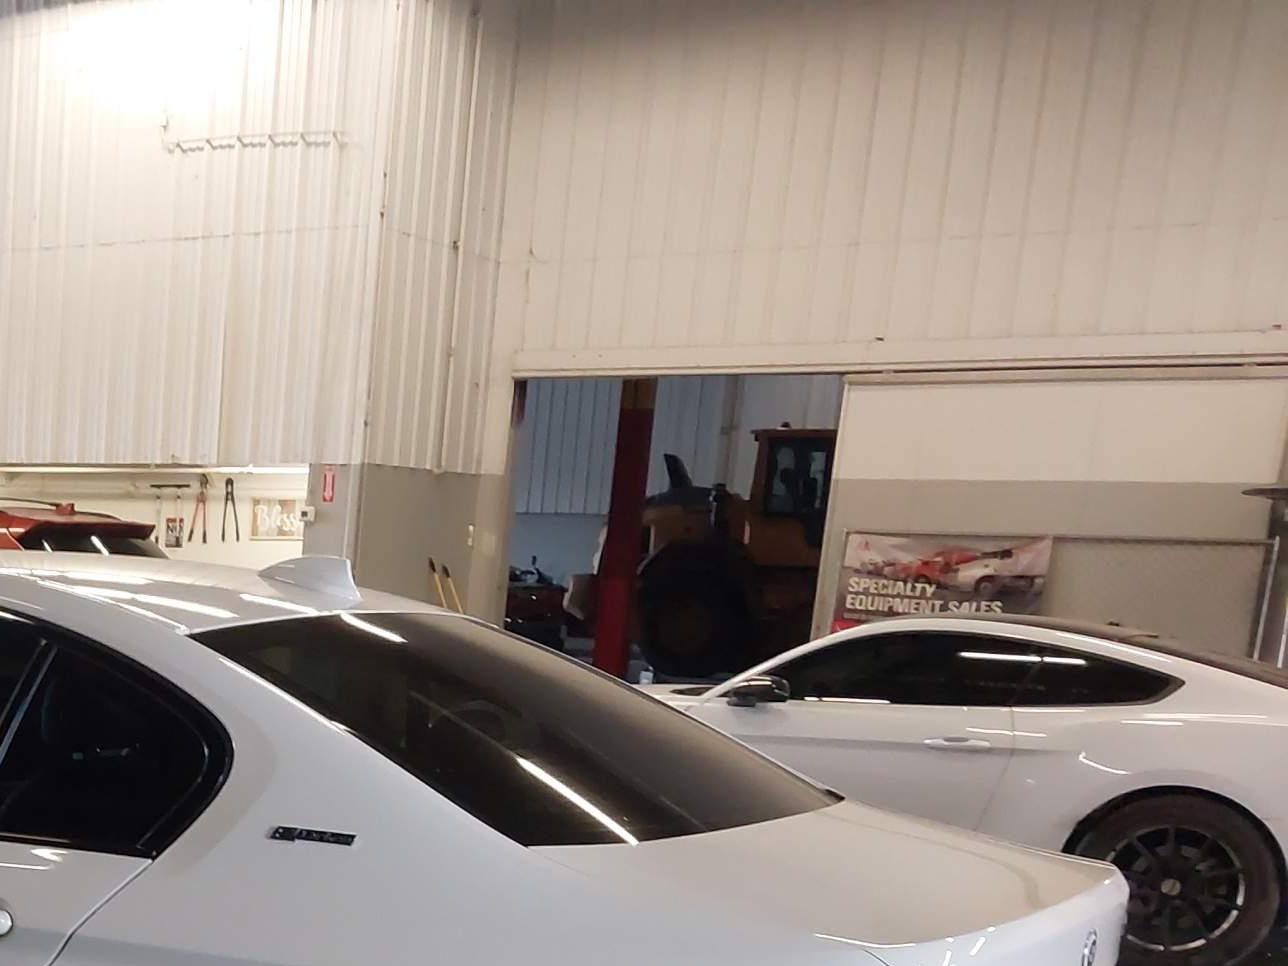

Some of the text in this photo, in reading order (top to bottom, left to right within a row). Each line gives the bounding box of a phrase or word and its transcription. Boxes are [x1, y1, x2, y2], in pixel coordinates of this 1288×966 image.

[848, 576, 936, 597] SPECIALTY
[845, 594, 1004, 614] EQUIPMENT SALES
